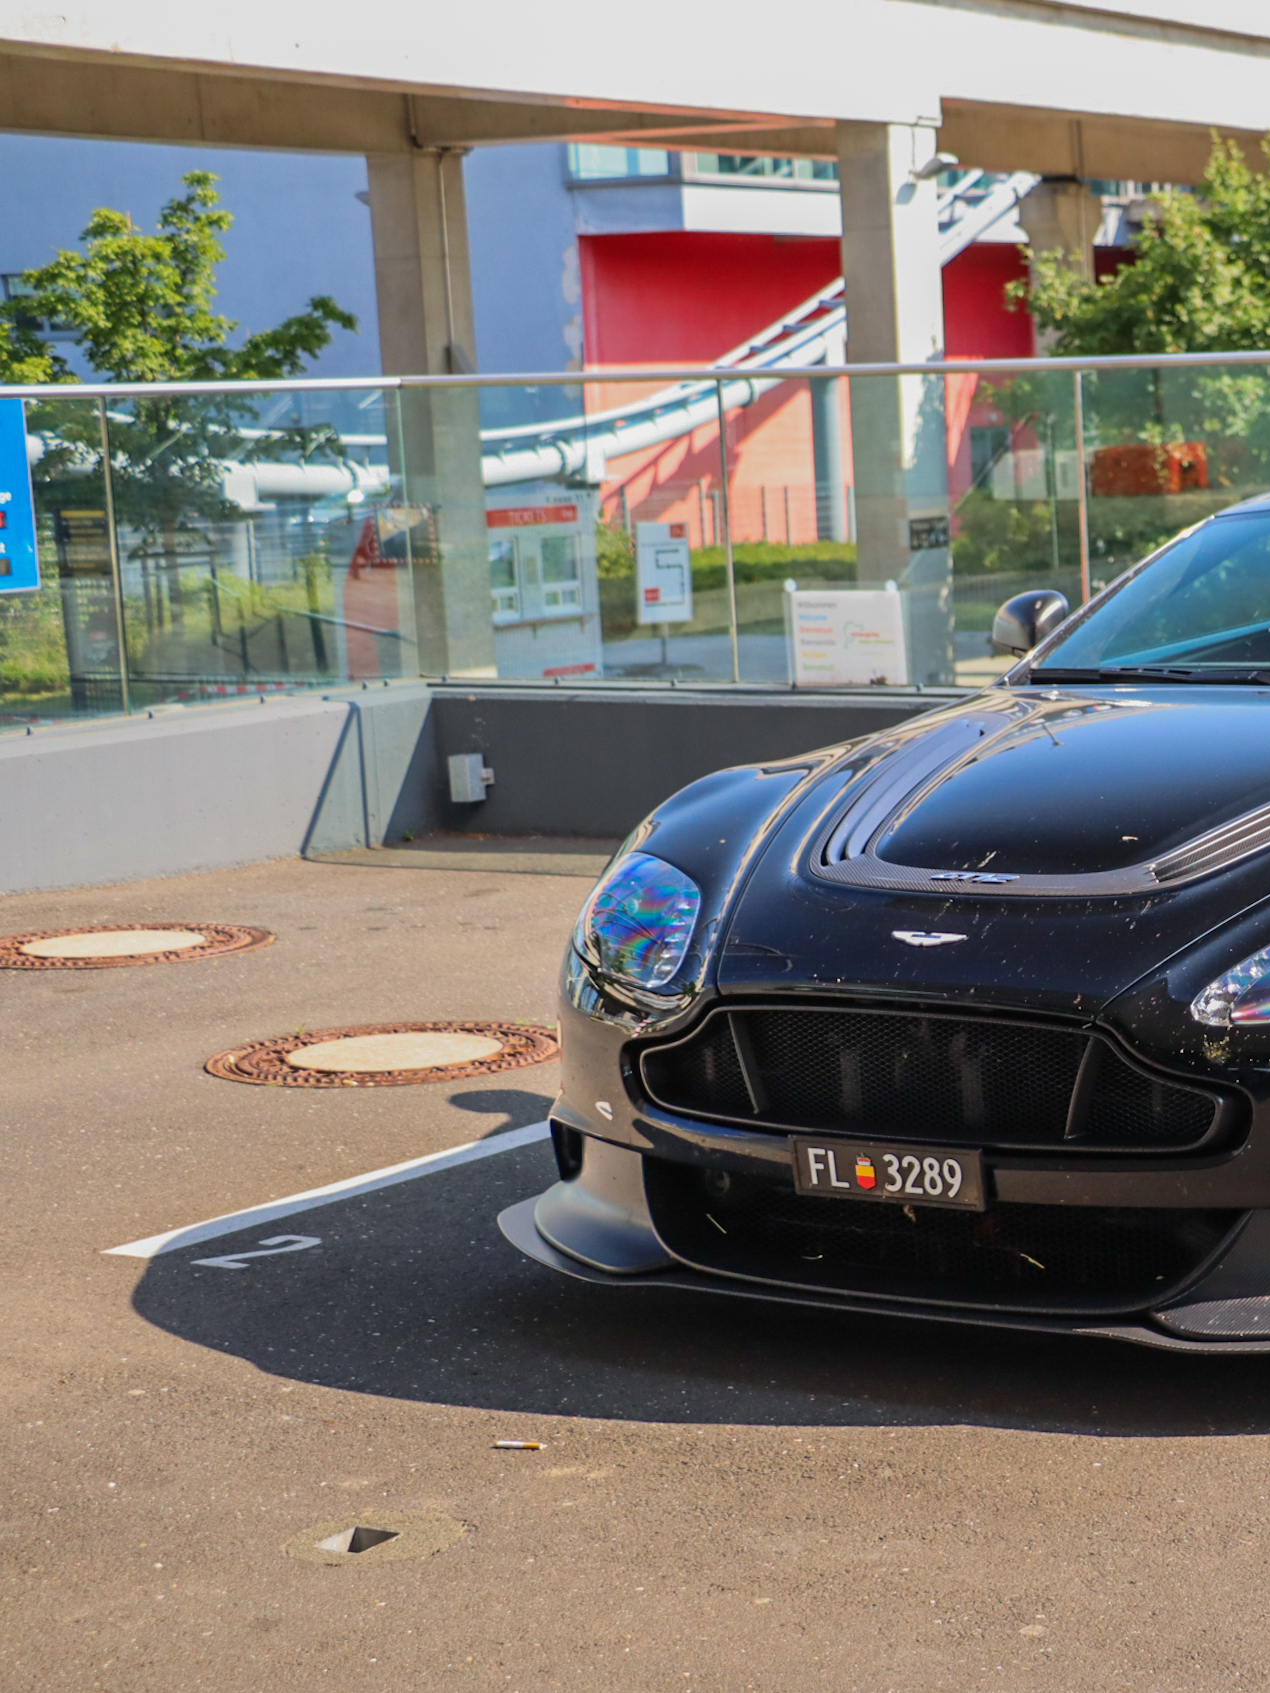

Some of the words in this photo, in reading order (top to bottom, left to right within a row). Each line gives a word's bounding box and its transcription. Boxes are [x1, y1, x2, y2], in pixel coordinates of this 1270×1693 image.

[808, 1148, 850, 1188] FL
[882, 1153, 962, 1198] 3289
[190, 1235, 322, 1269] 2
